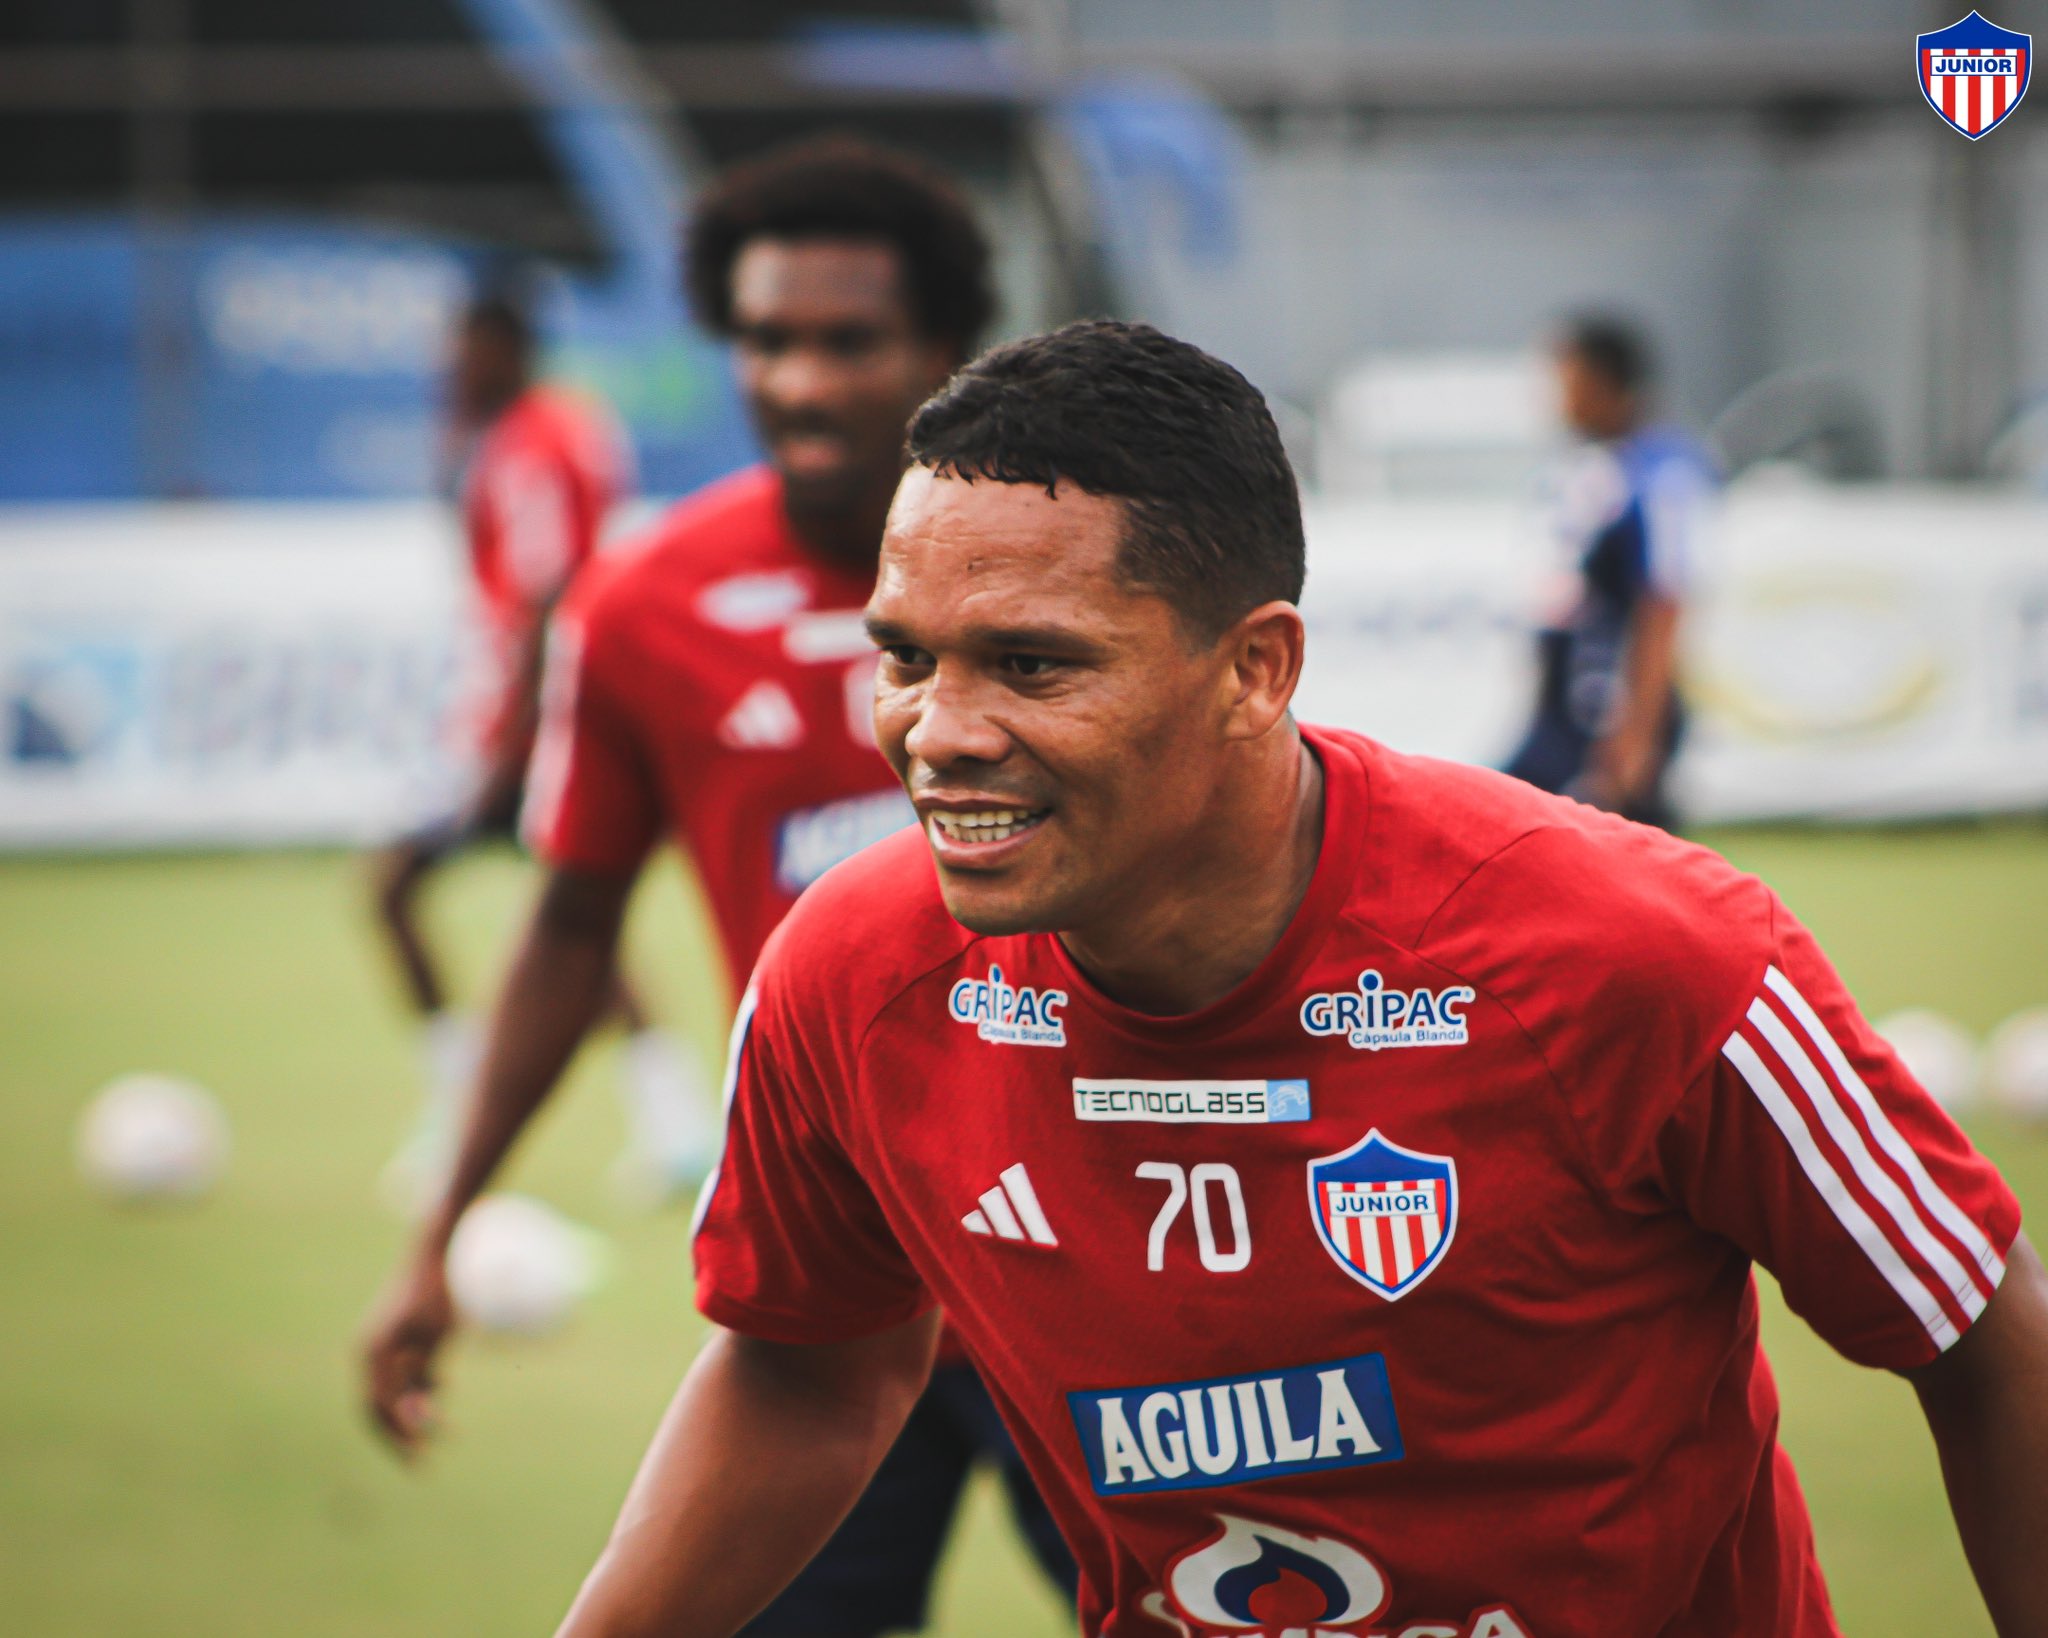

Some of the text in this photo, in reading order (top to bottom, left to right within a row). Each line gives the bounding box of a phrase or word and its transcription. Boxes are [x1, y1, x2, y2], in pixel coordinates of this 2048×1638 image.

[1416, 1028, 1464, 1041] Blanda
[1135, 1162, 1251, 1272] 70
[1336, 1194, 1429, 1212] JUNIOR
[1097, 1368, 1382, 1485] AGUILA
